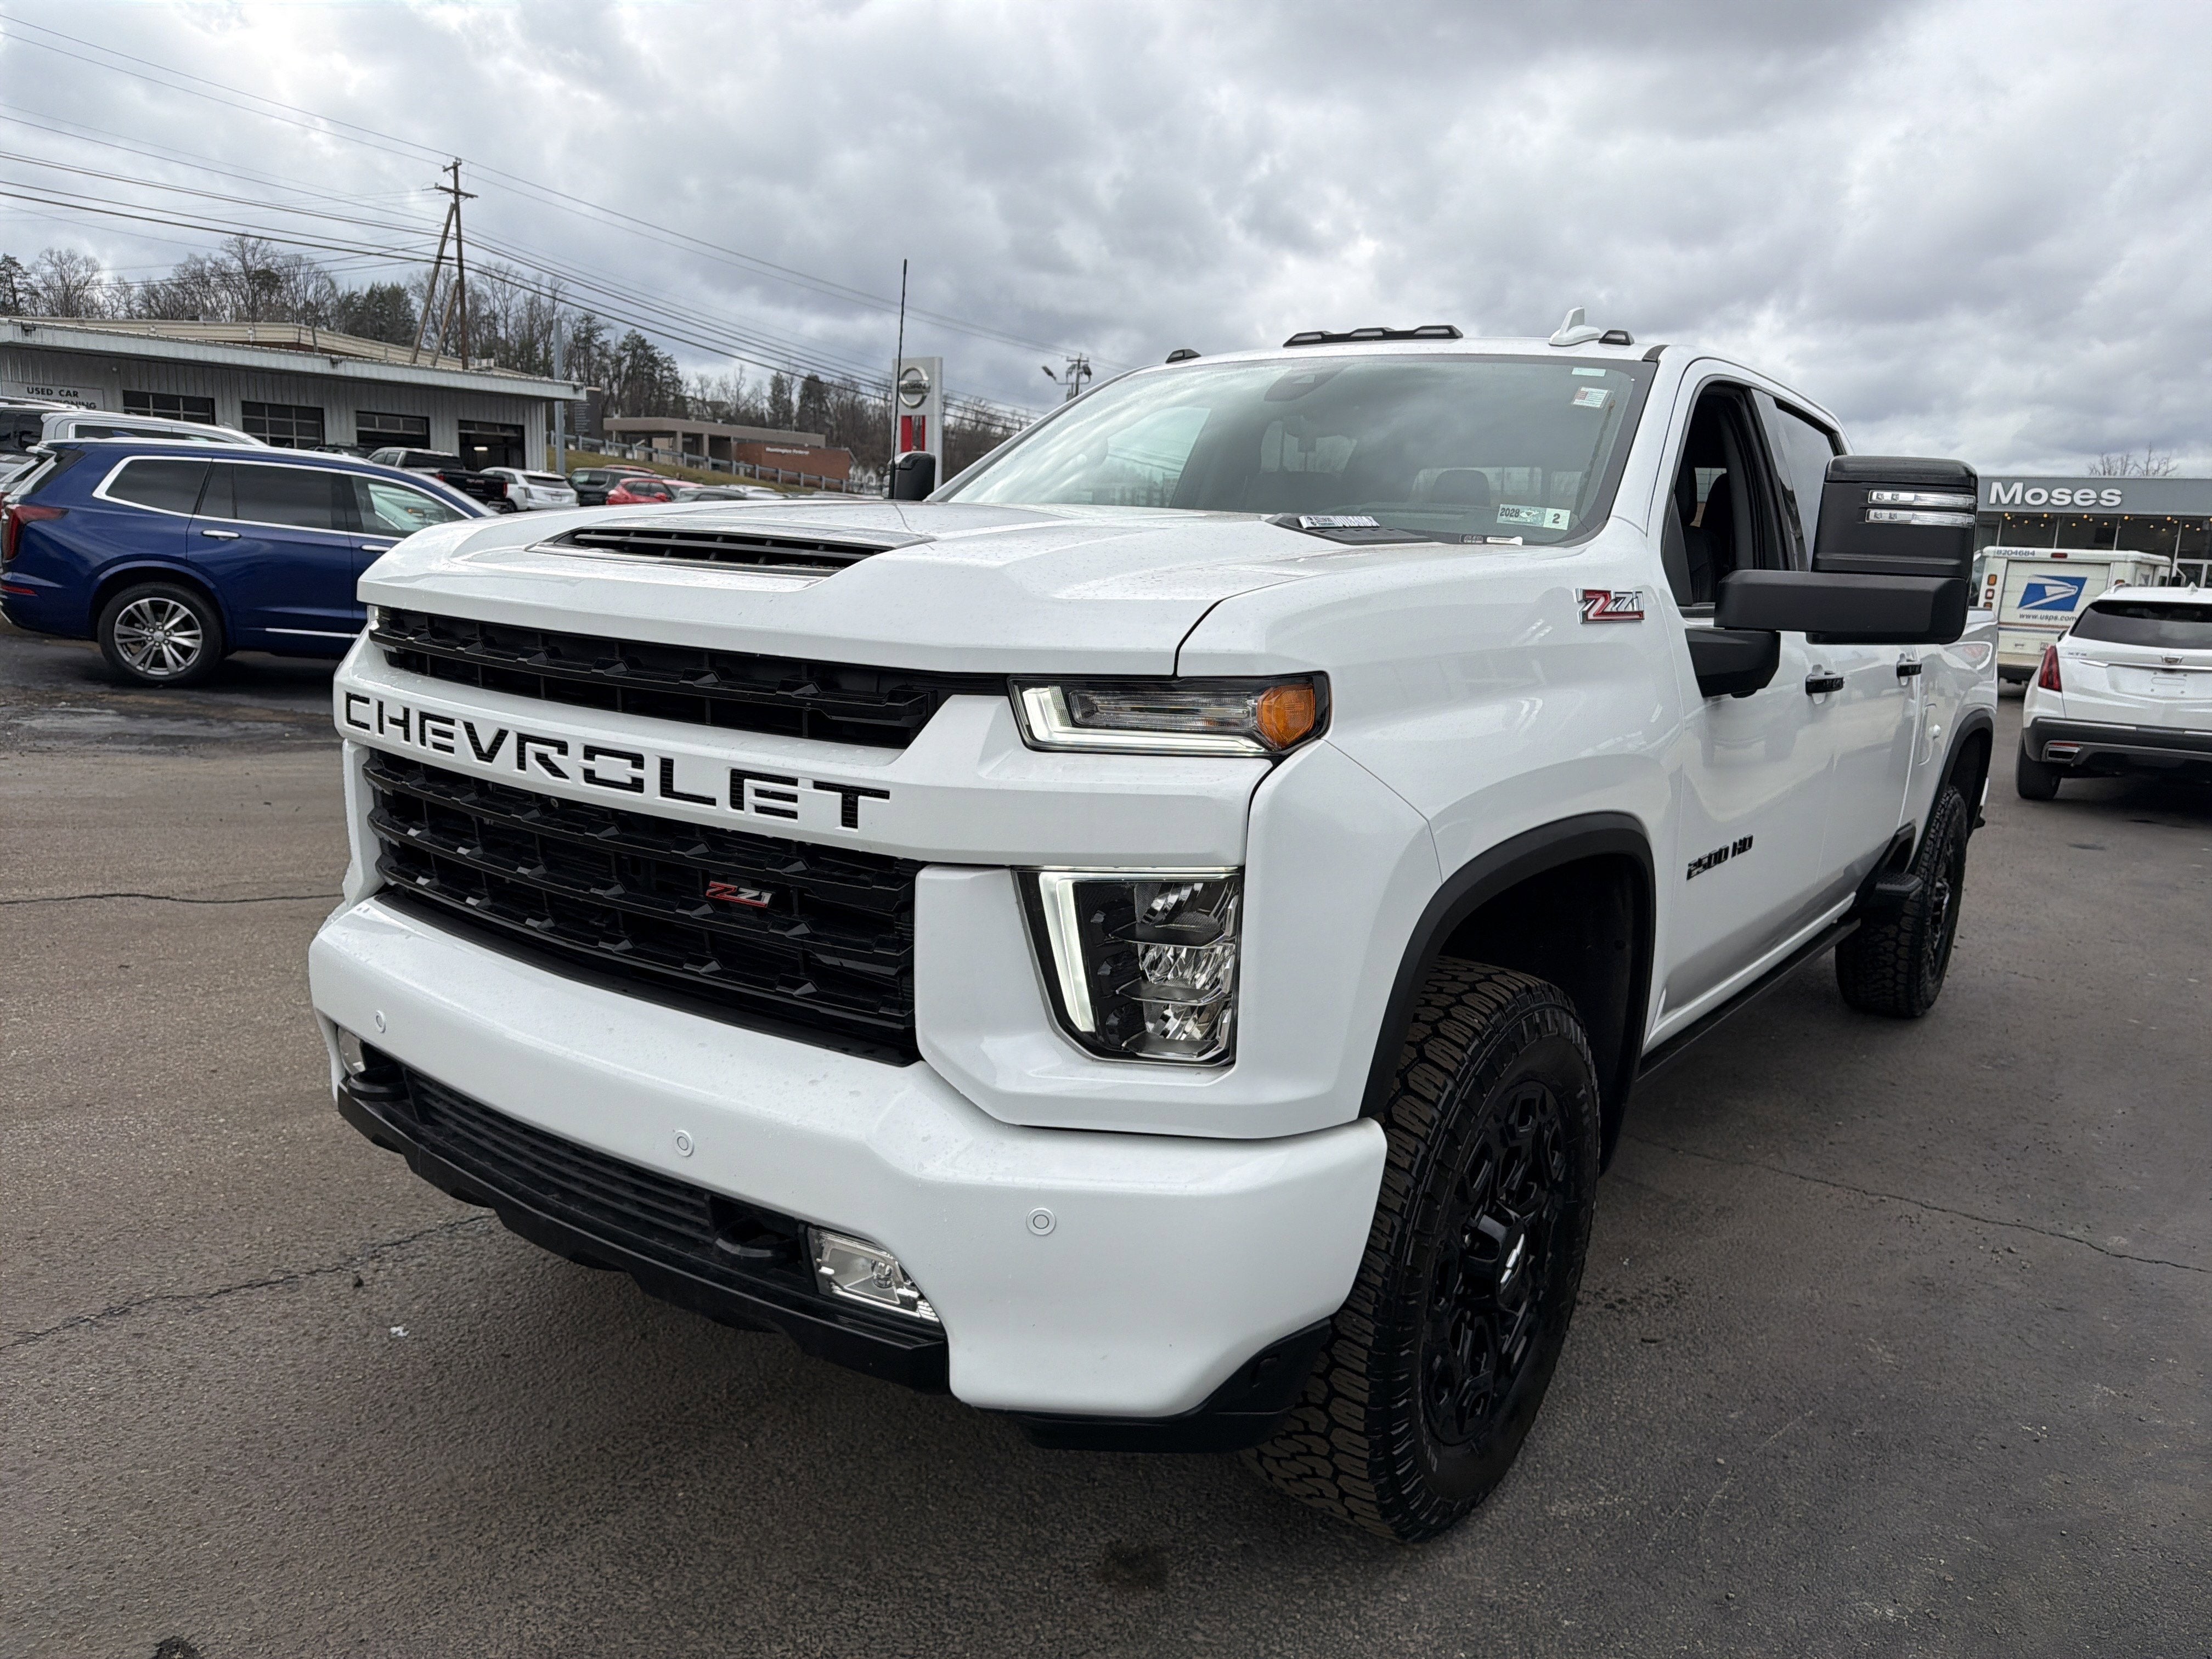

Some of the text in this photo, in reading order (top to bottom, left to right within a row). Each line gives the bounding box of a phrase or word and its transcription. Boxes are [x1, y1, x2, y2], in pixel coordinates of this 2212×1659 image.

[27, 386, 79, 398] USED CAR
[1989, 482, 2122, 506] Moses
[1499, 507, 1561, 524] 2028 2
[1573, 588, 1645, 624] Z71
[2019, 613, 2076, 622] www.usps.com
[345, 691, 890, 830] CHEVROLET
[1686, 834, 1753, 881] 2500 HD
[705, 880, 772, 908] Z71
